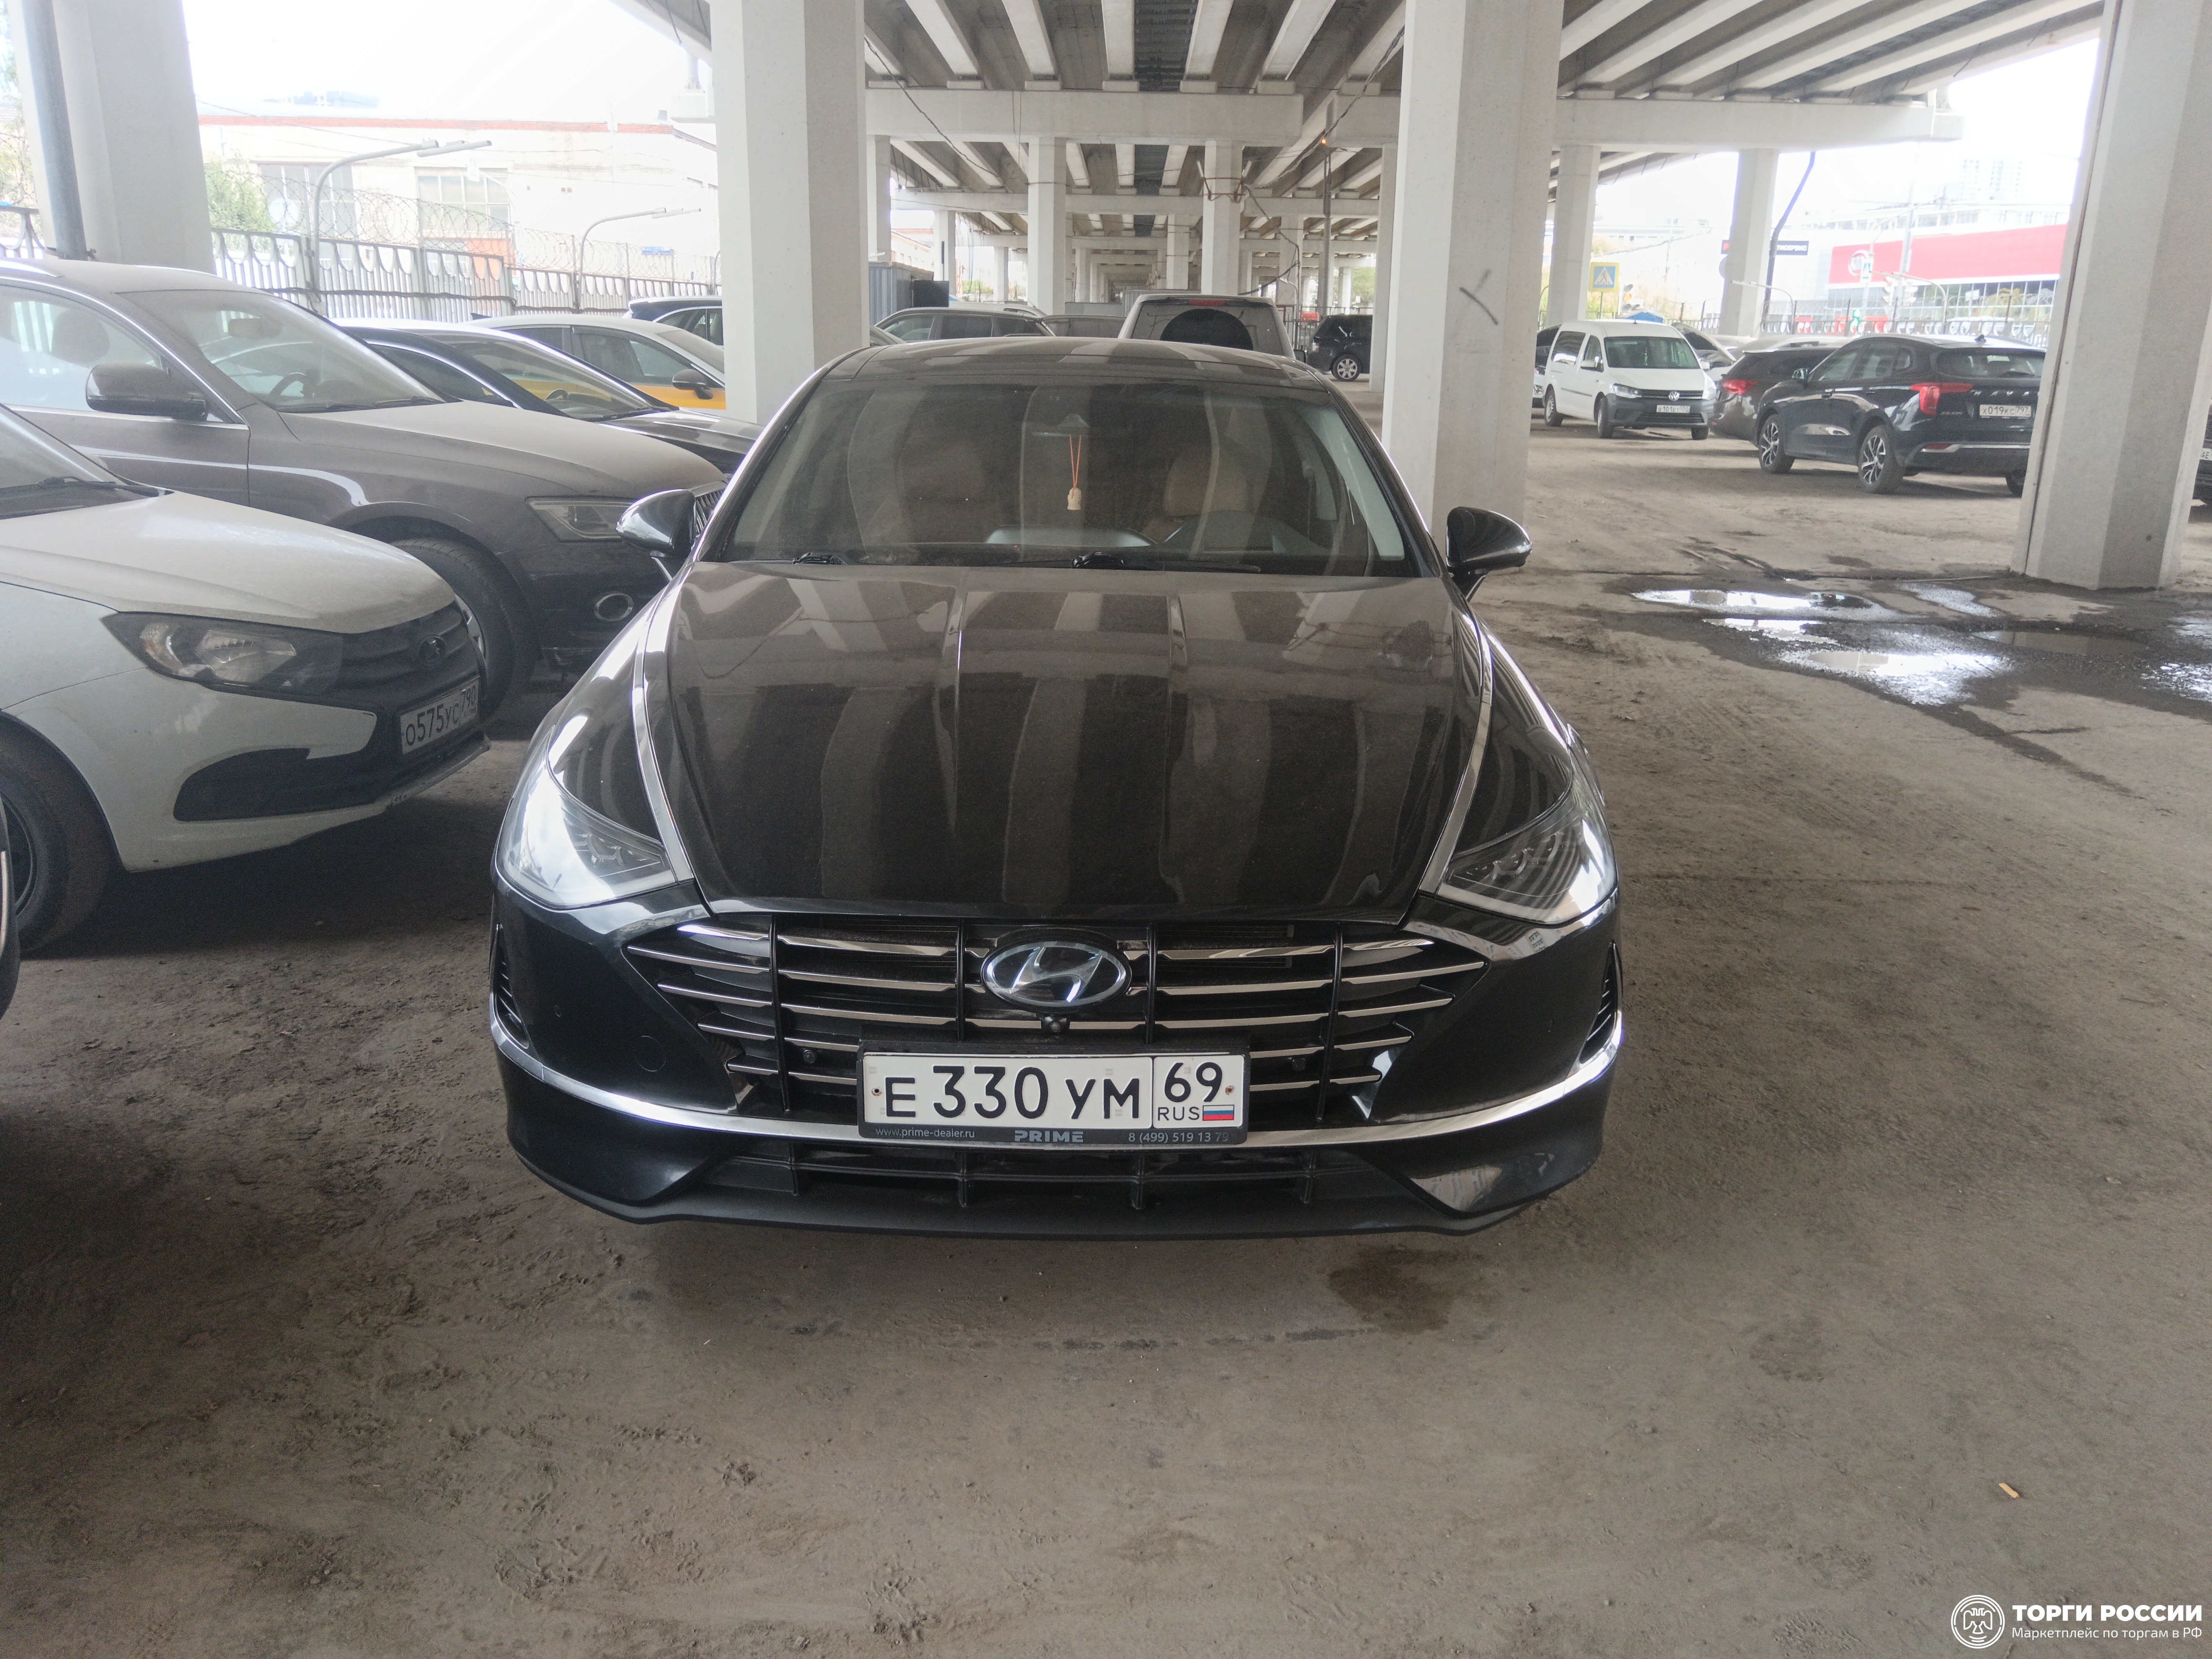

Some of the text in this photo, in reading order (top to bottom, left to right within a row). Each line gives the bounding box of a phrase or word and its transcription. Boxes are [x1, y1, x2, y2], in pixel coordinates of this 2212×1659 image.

[1164, 1061, 1223, 1103] 69
[1158, 1106, 1200, 1121] RUS
[876, 1127, 975, 1139] www.prime-dealer.ru
[1014, 1129, 1083, 1143] PRIME
[1128, 1133, 1136, 1142] 8
[1139, 1132, 1169, 1143] (499)
[1172, 1132, 1194, 1142] 519
[1198, 1132, 1211, 1142] 13
